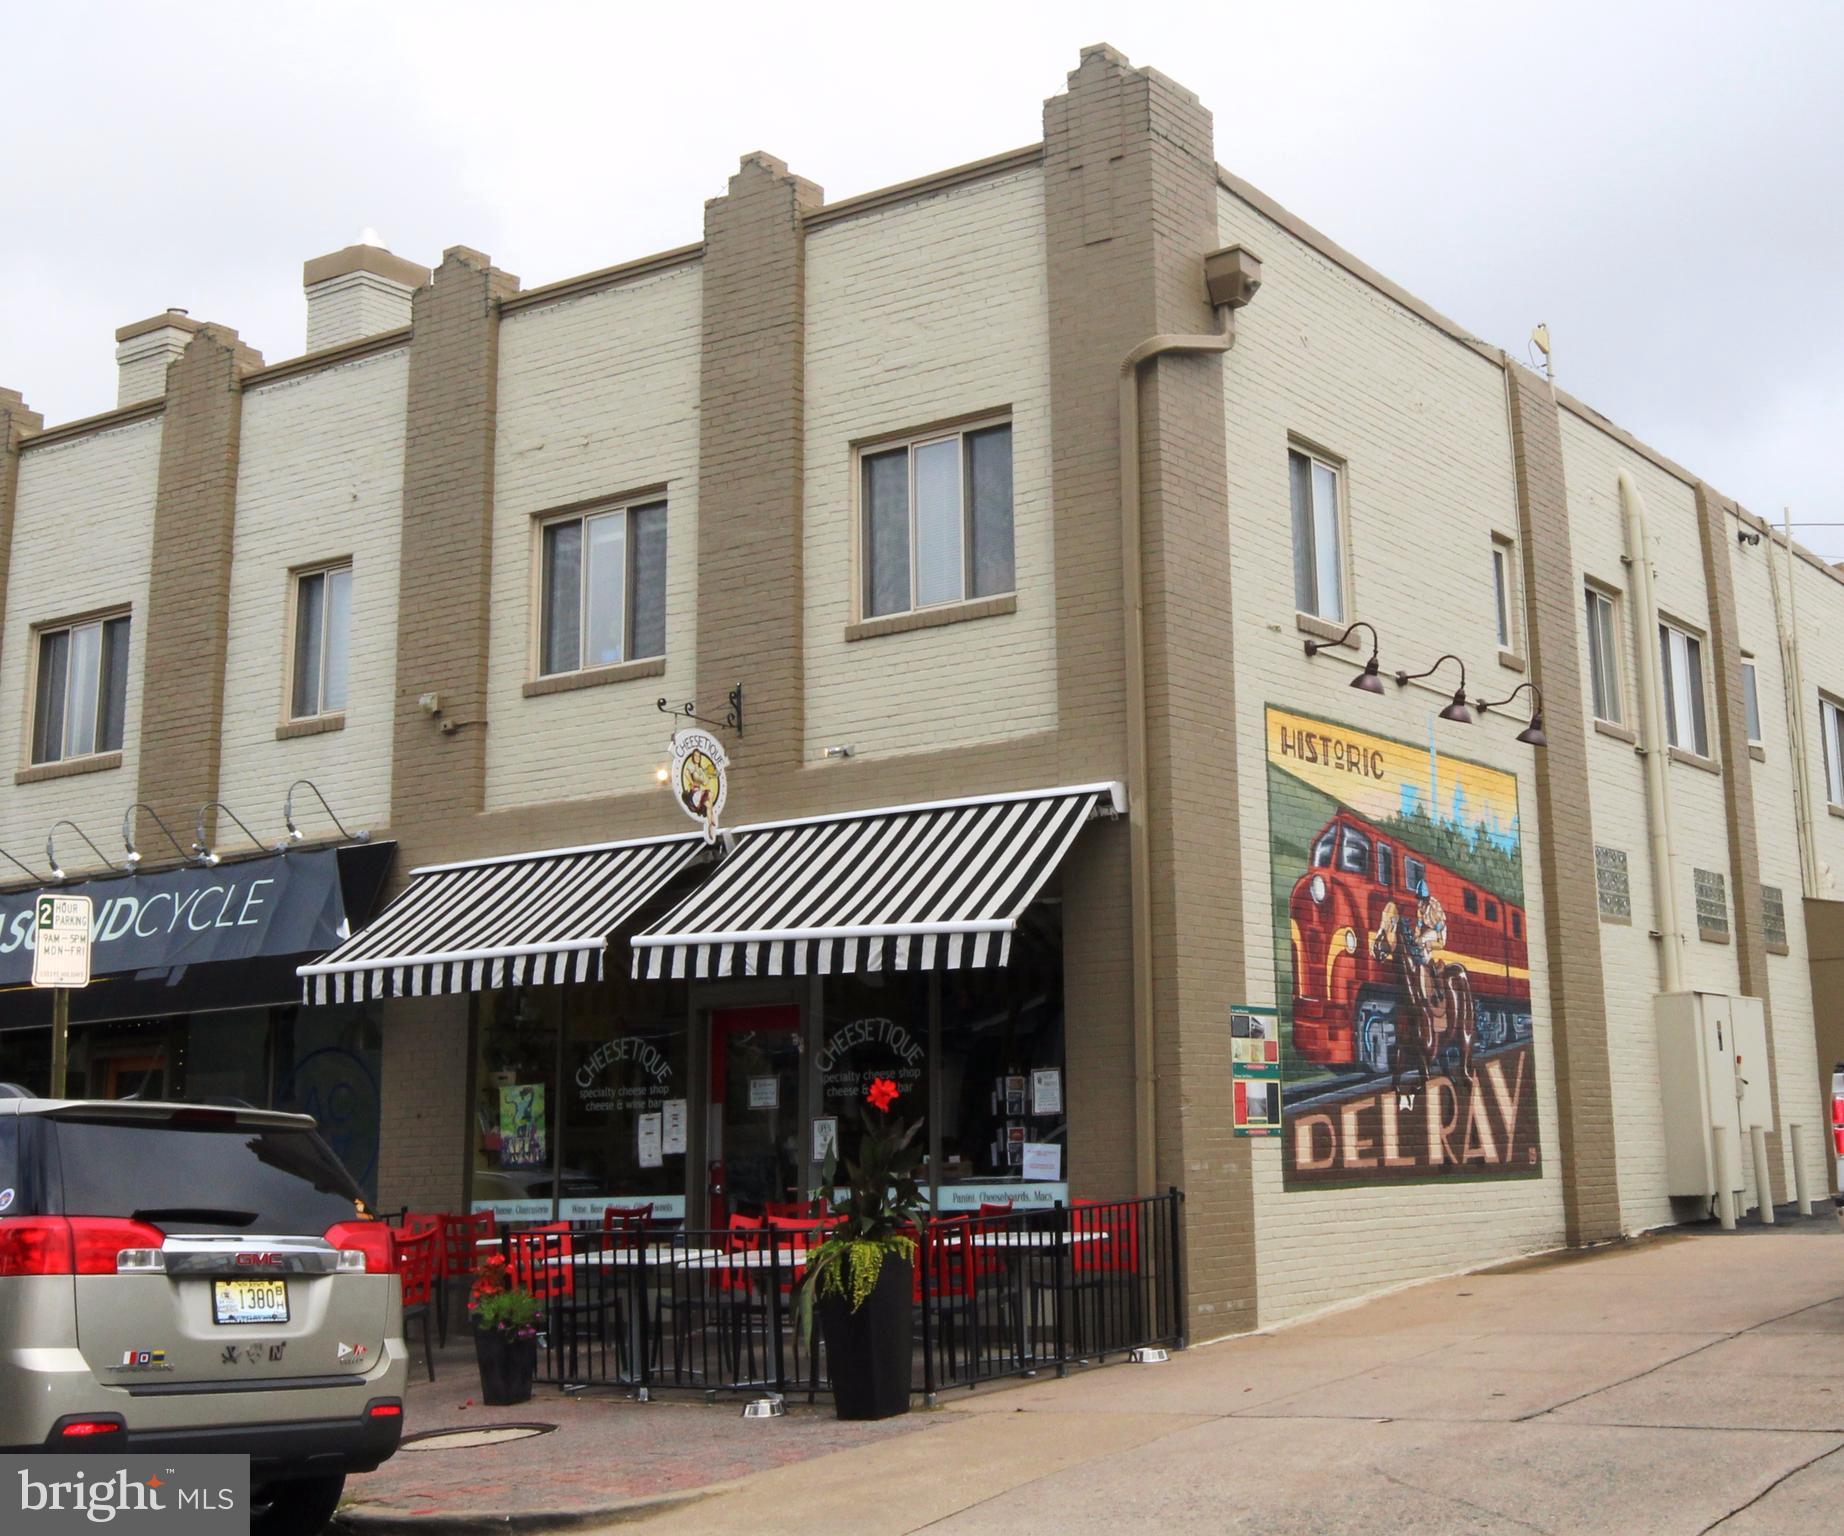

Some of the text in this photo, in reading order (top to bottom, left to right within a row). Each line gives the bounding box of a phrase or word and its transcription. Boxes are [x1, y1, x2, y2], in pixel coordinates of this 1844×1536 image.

[675, 735, 725, 767] CHEESETIQUE
[1281, 726, 1384, 780] HISTORIC
[40, 903, 52, 924] 2
[56, 903, 79, 914] HOUR
[55, 916, 87, 927] PARKING
[815, 1017, 925, 1072] CHEESETIQUE
[575, 1037, 672, 1088] CHEESETIQUE
[863, 1069, 895, 1080] cheese
[898, 1067, 921, 1079] shop
[580, 1085, 670, 1099] specialty cheese shop
[827, 1085, 859, 1097] cheese
[897, 1083, 913, 1093] bar
[586, 1101, 615, 1112] cheese
[626, 1100, 646, 1109] wine
[1294, 1051, 1526, 1170] DEL RAY
[235, 1252, 282, 1265] GMC
